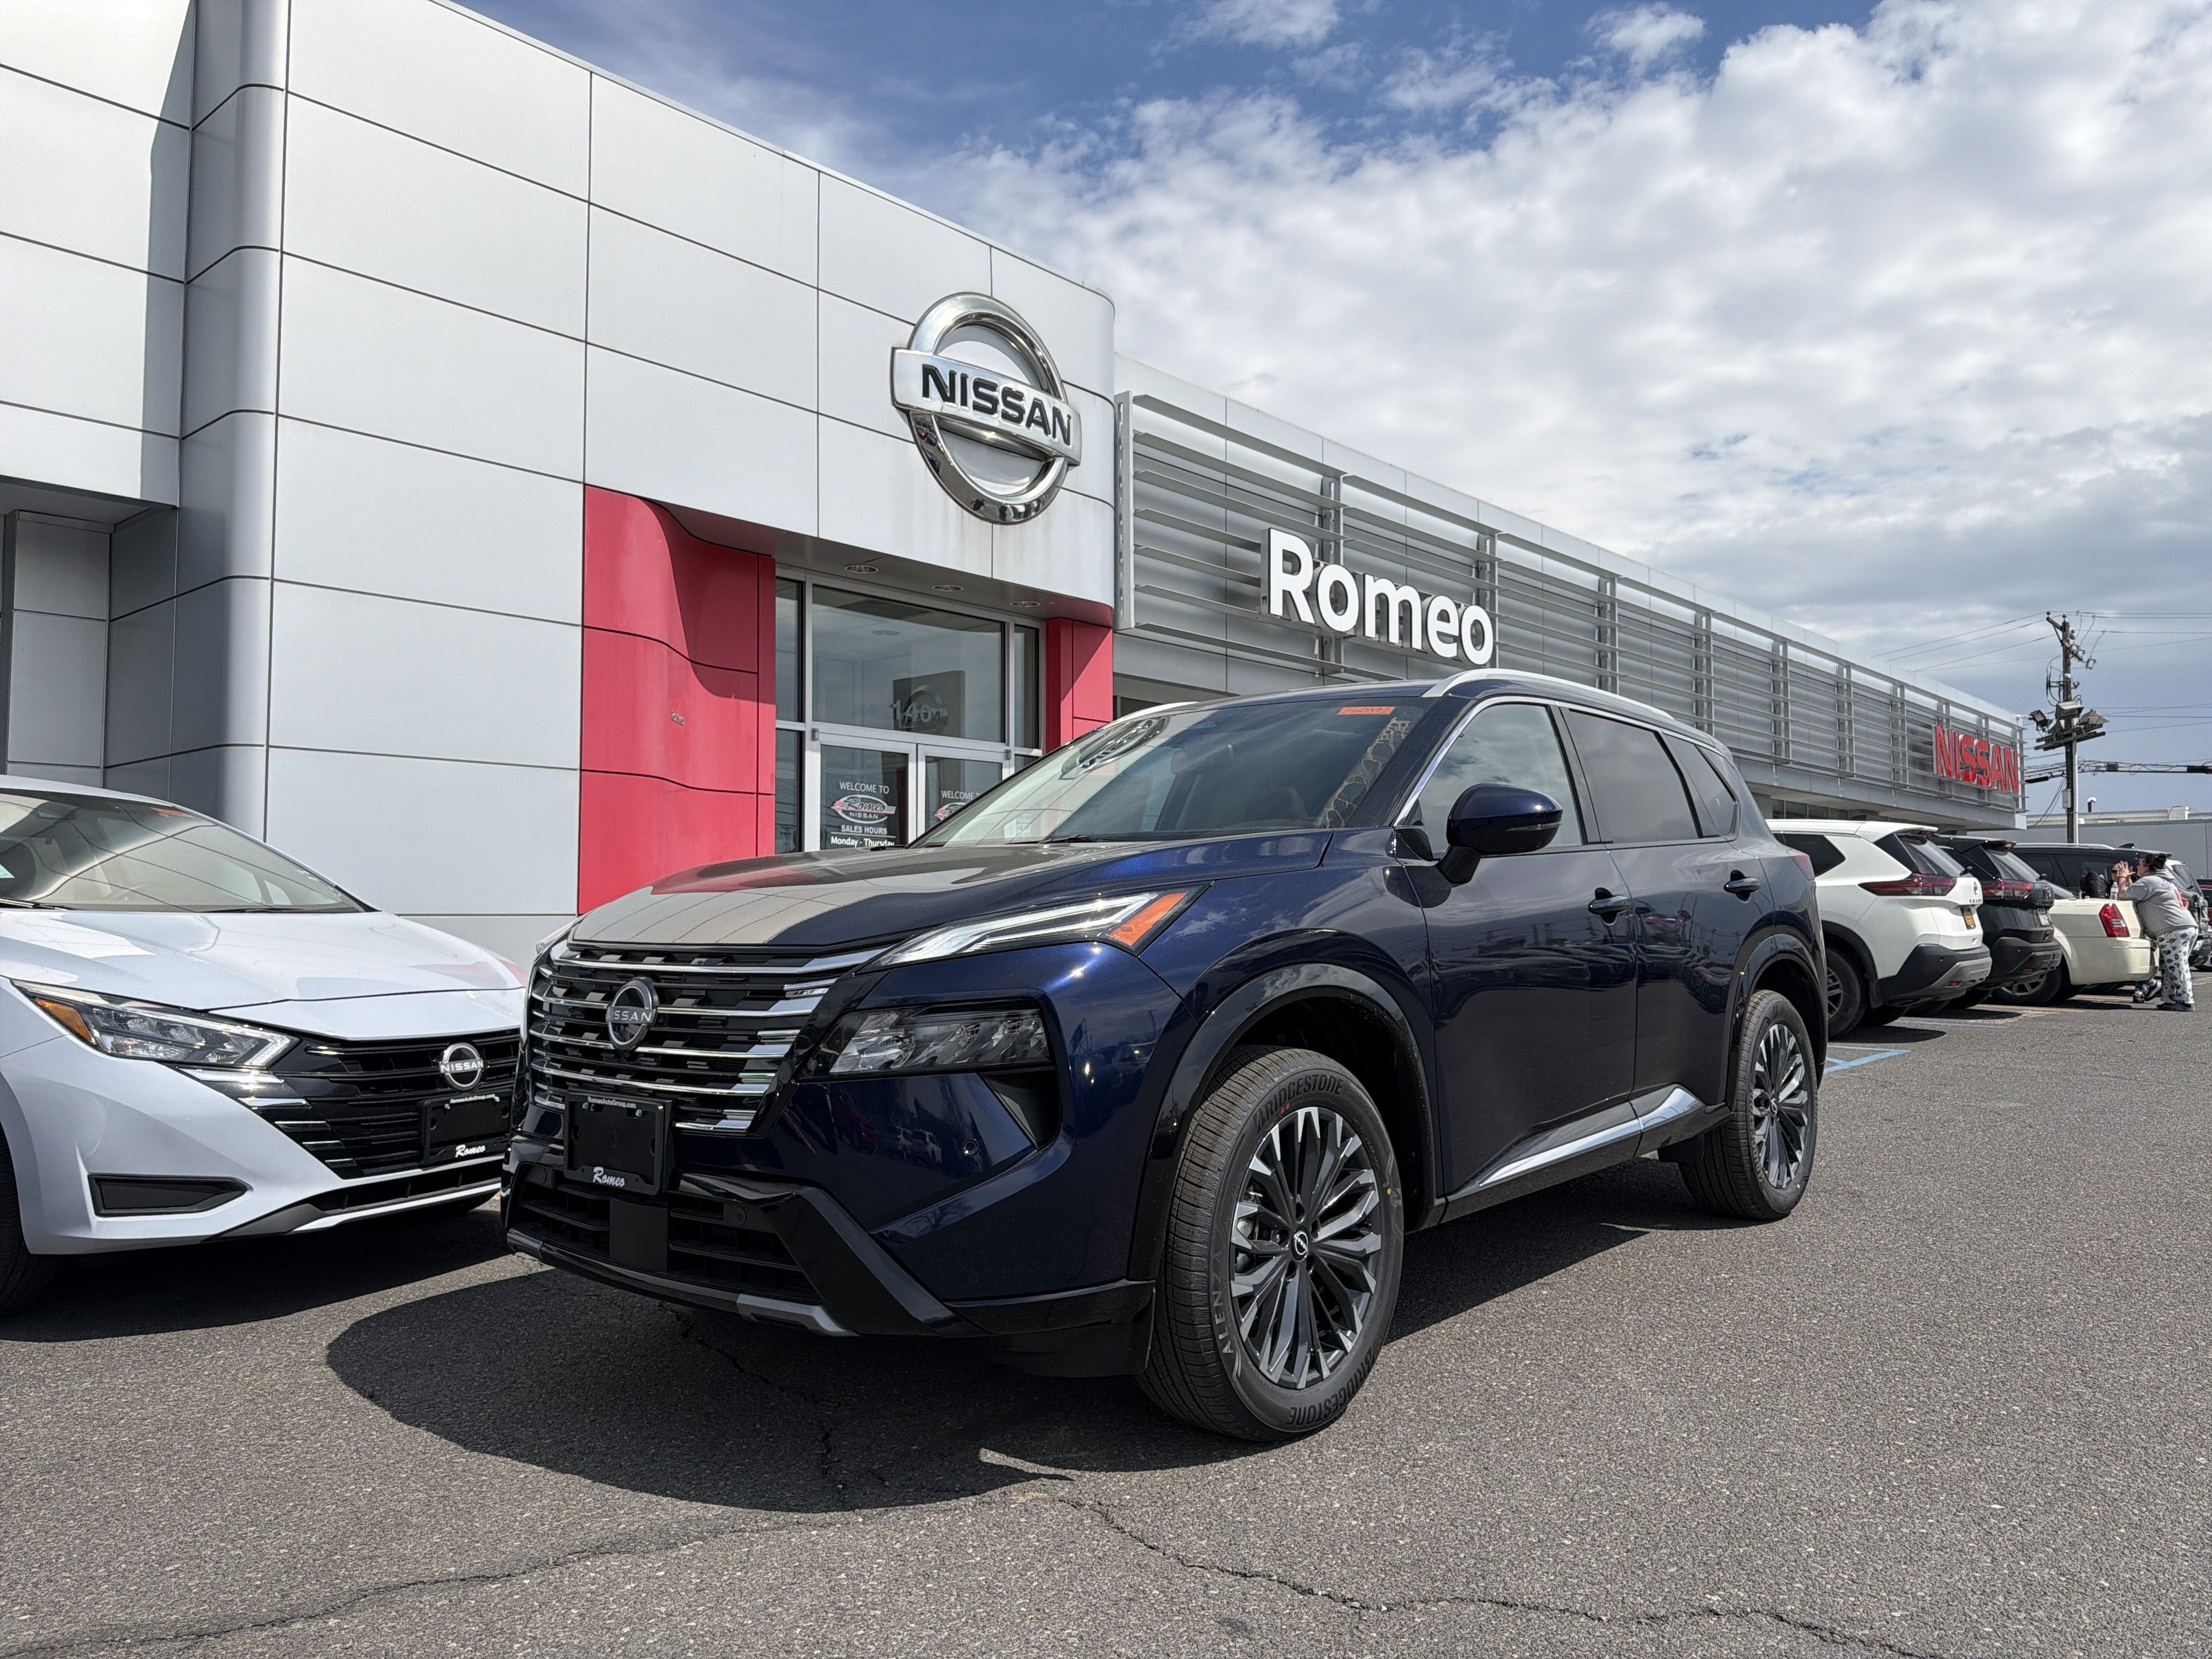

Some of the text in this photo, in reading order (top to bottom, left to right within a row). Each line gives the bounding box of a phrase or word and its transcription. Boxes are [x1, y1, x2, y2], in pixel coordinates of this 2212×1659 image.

[922, 363, 1073, 448] NISSAN
[1268, 527, 1494, 665] Romeo
[891, 699, 932, 723] 140
[1935, 724, 2019, 795] NISSAN
[839, 781, 889, 794] WELCOME TO
[941, 790, 974, 800] WELCOME
[845, 795, 886, 812] Romeo
[841, 825, 888, 835] SALES HOURS
[831, 836, 858, 848] Monday
[864, 838, 895, 847] Thursday
[441, 1060, 483, 1073] NISSAN
[588, 1096, 636, 1109] RomeoAutoGroup.com
[1252, 1074, 1344, 1135] BRIDGESTONE
[455, 1144, 486, 1158] Romeo
[593, 1167, 625, 1187] Romeo
[1286, 1347, 1374, 1425] BRIDGESTONE
